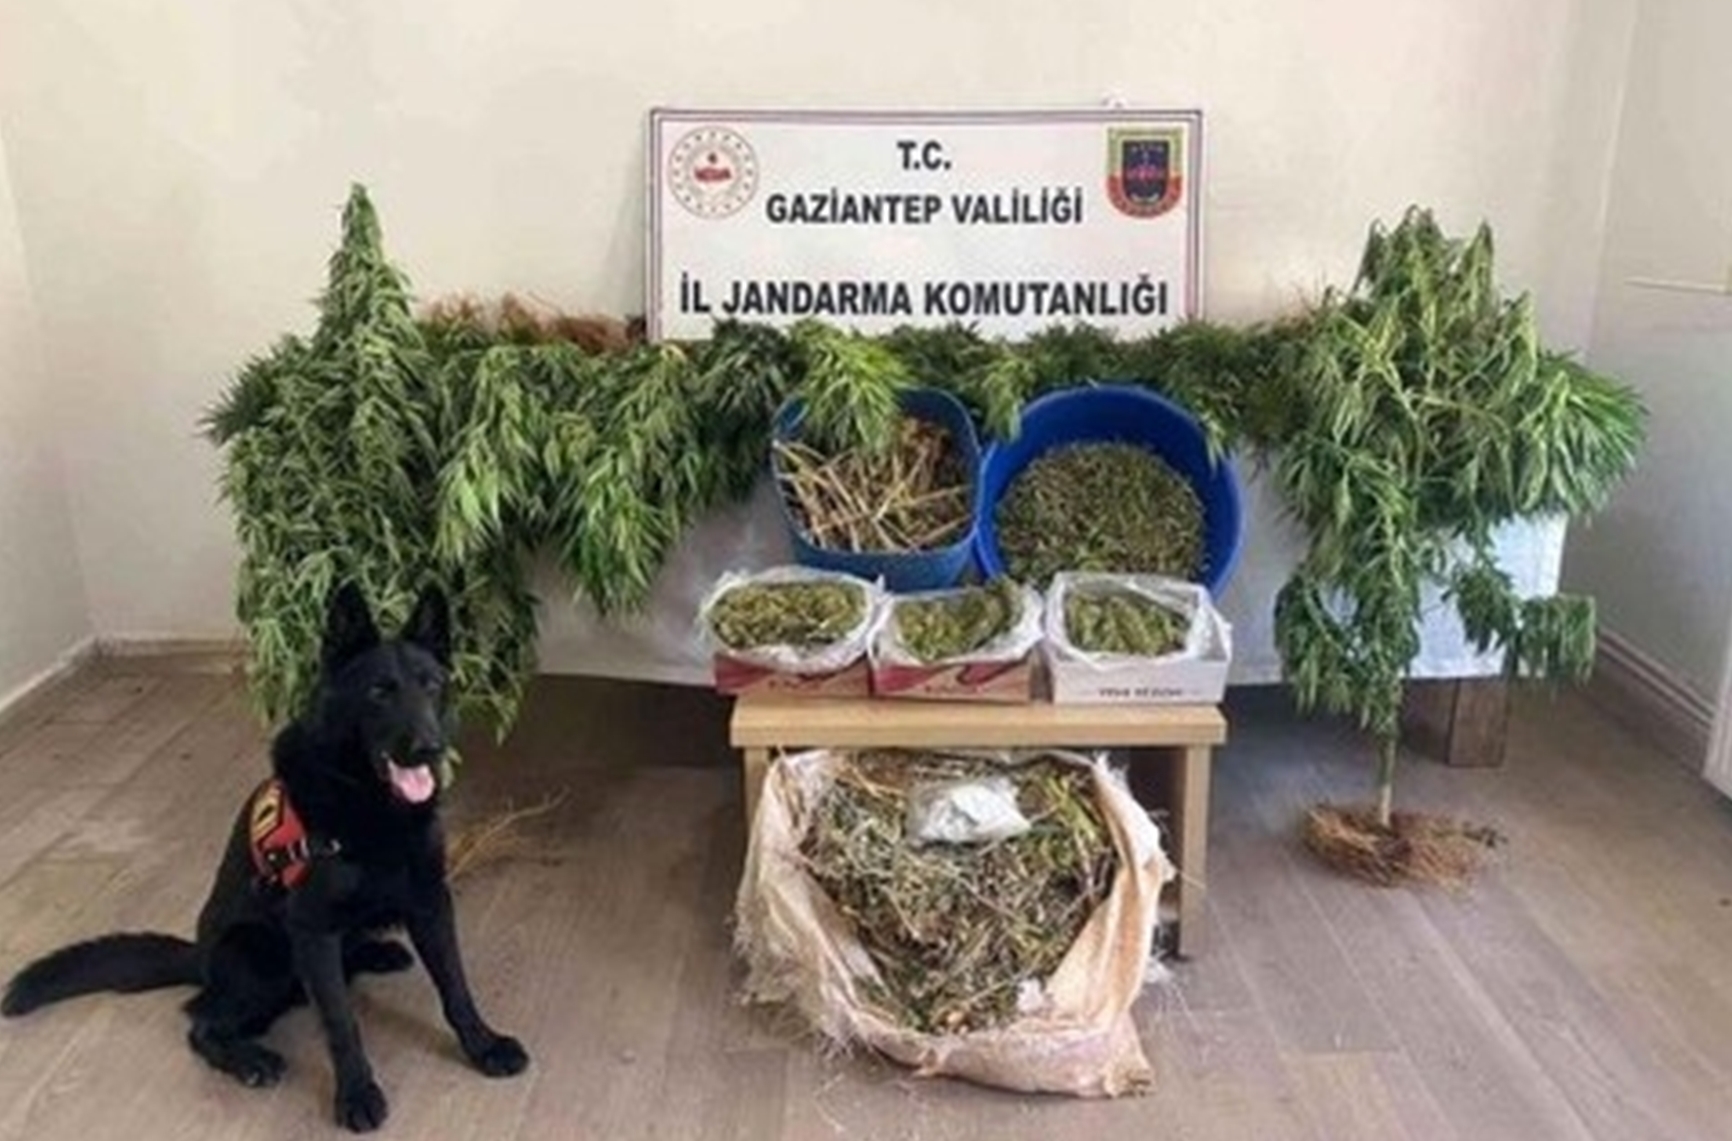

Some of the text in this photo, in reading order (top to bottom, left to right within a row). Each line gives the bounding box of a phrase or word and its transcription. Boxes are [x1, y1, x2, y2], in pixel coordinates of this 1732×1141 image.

[897, 141, 952, 170] T.C.
[766, 187, 1082, 224] GAZİANTEP VALİLİĞİ
[680, 272, 1167, 315] İL JANDARMA KOMUTANLIĞI
